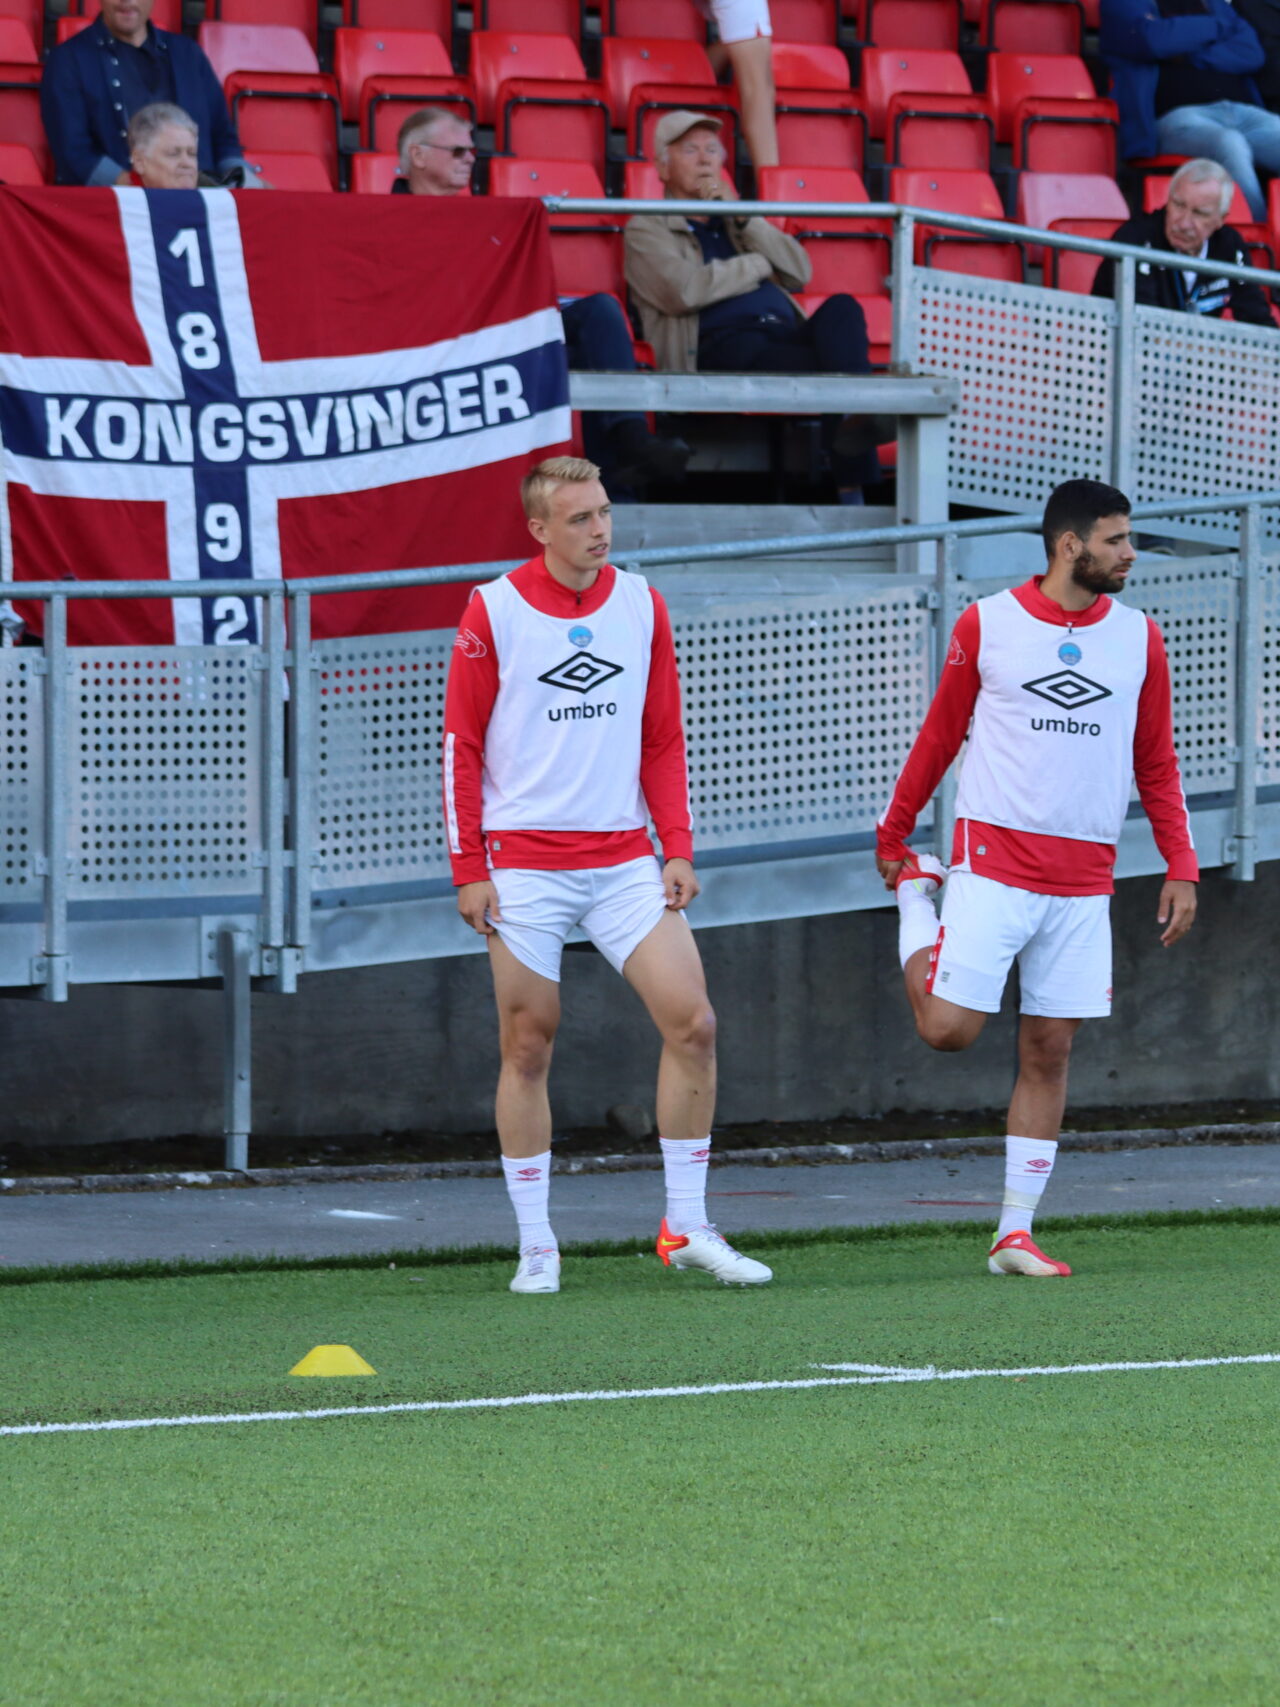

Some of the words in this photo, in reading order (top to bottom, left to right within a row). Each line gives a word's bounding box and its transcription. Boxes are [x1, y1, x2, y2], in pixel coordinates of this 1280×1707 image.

[45, 363, 530, 463] KONGSVINGER
[548, 702, 618, 722] umbro
[1030, 717, 1102, 737] umbro
